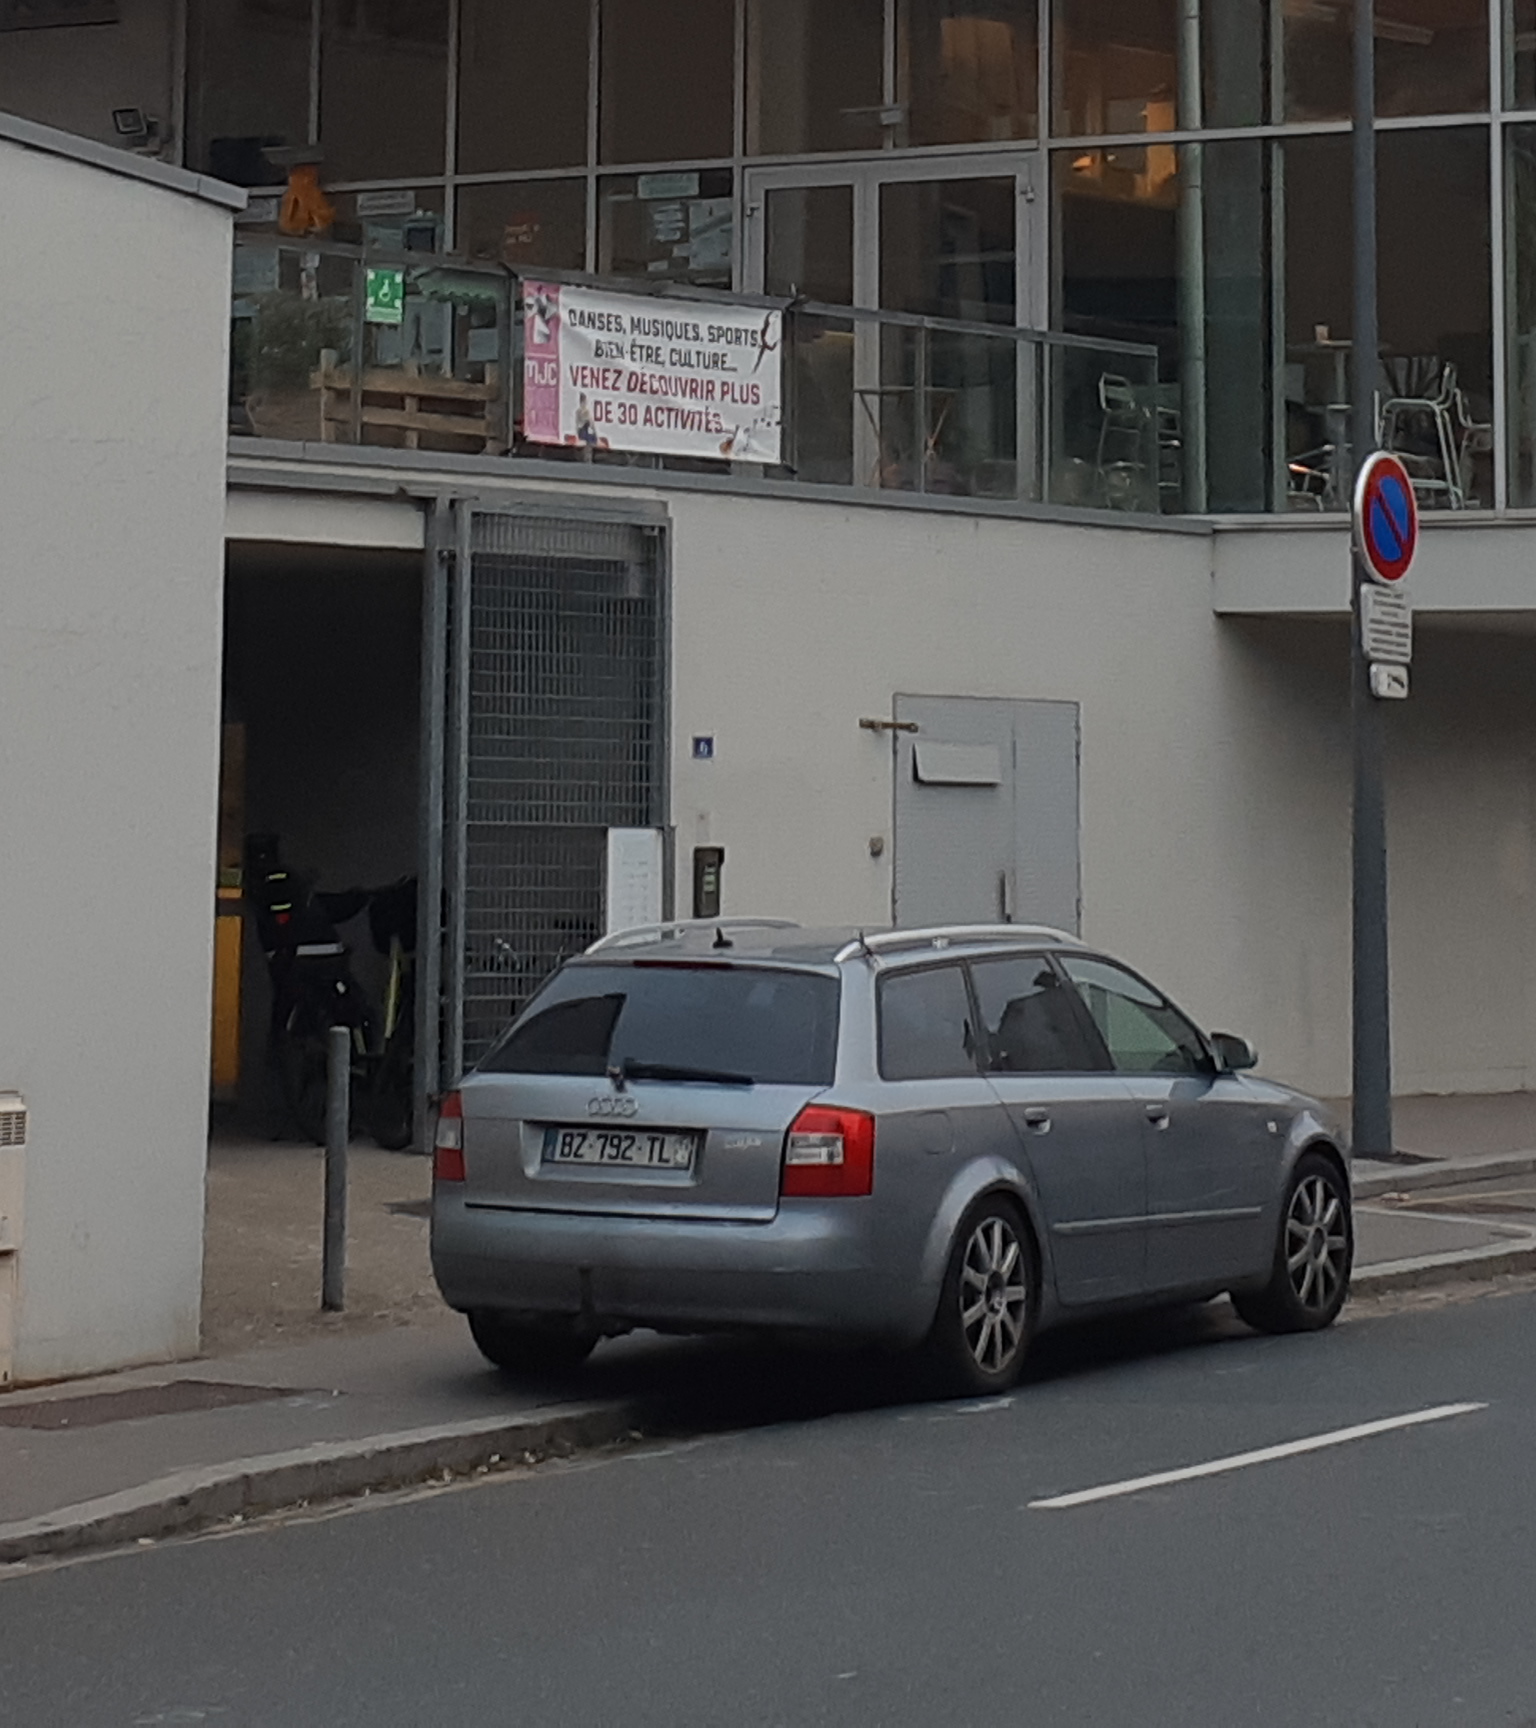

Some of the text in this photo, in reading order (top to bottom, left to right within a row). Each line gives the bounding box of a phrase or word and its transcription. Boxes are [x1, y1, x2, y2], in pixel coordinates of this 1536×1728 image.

[630, 316, 704, 343] MUSIQUES,
[569, 365, 761, 405] VENEZ DÉCOUVRIR PLUS
[593, 399, 613, 423] DE
[617, 402, 638, 425] 30
